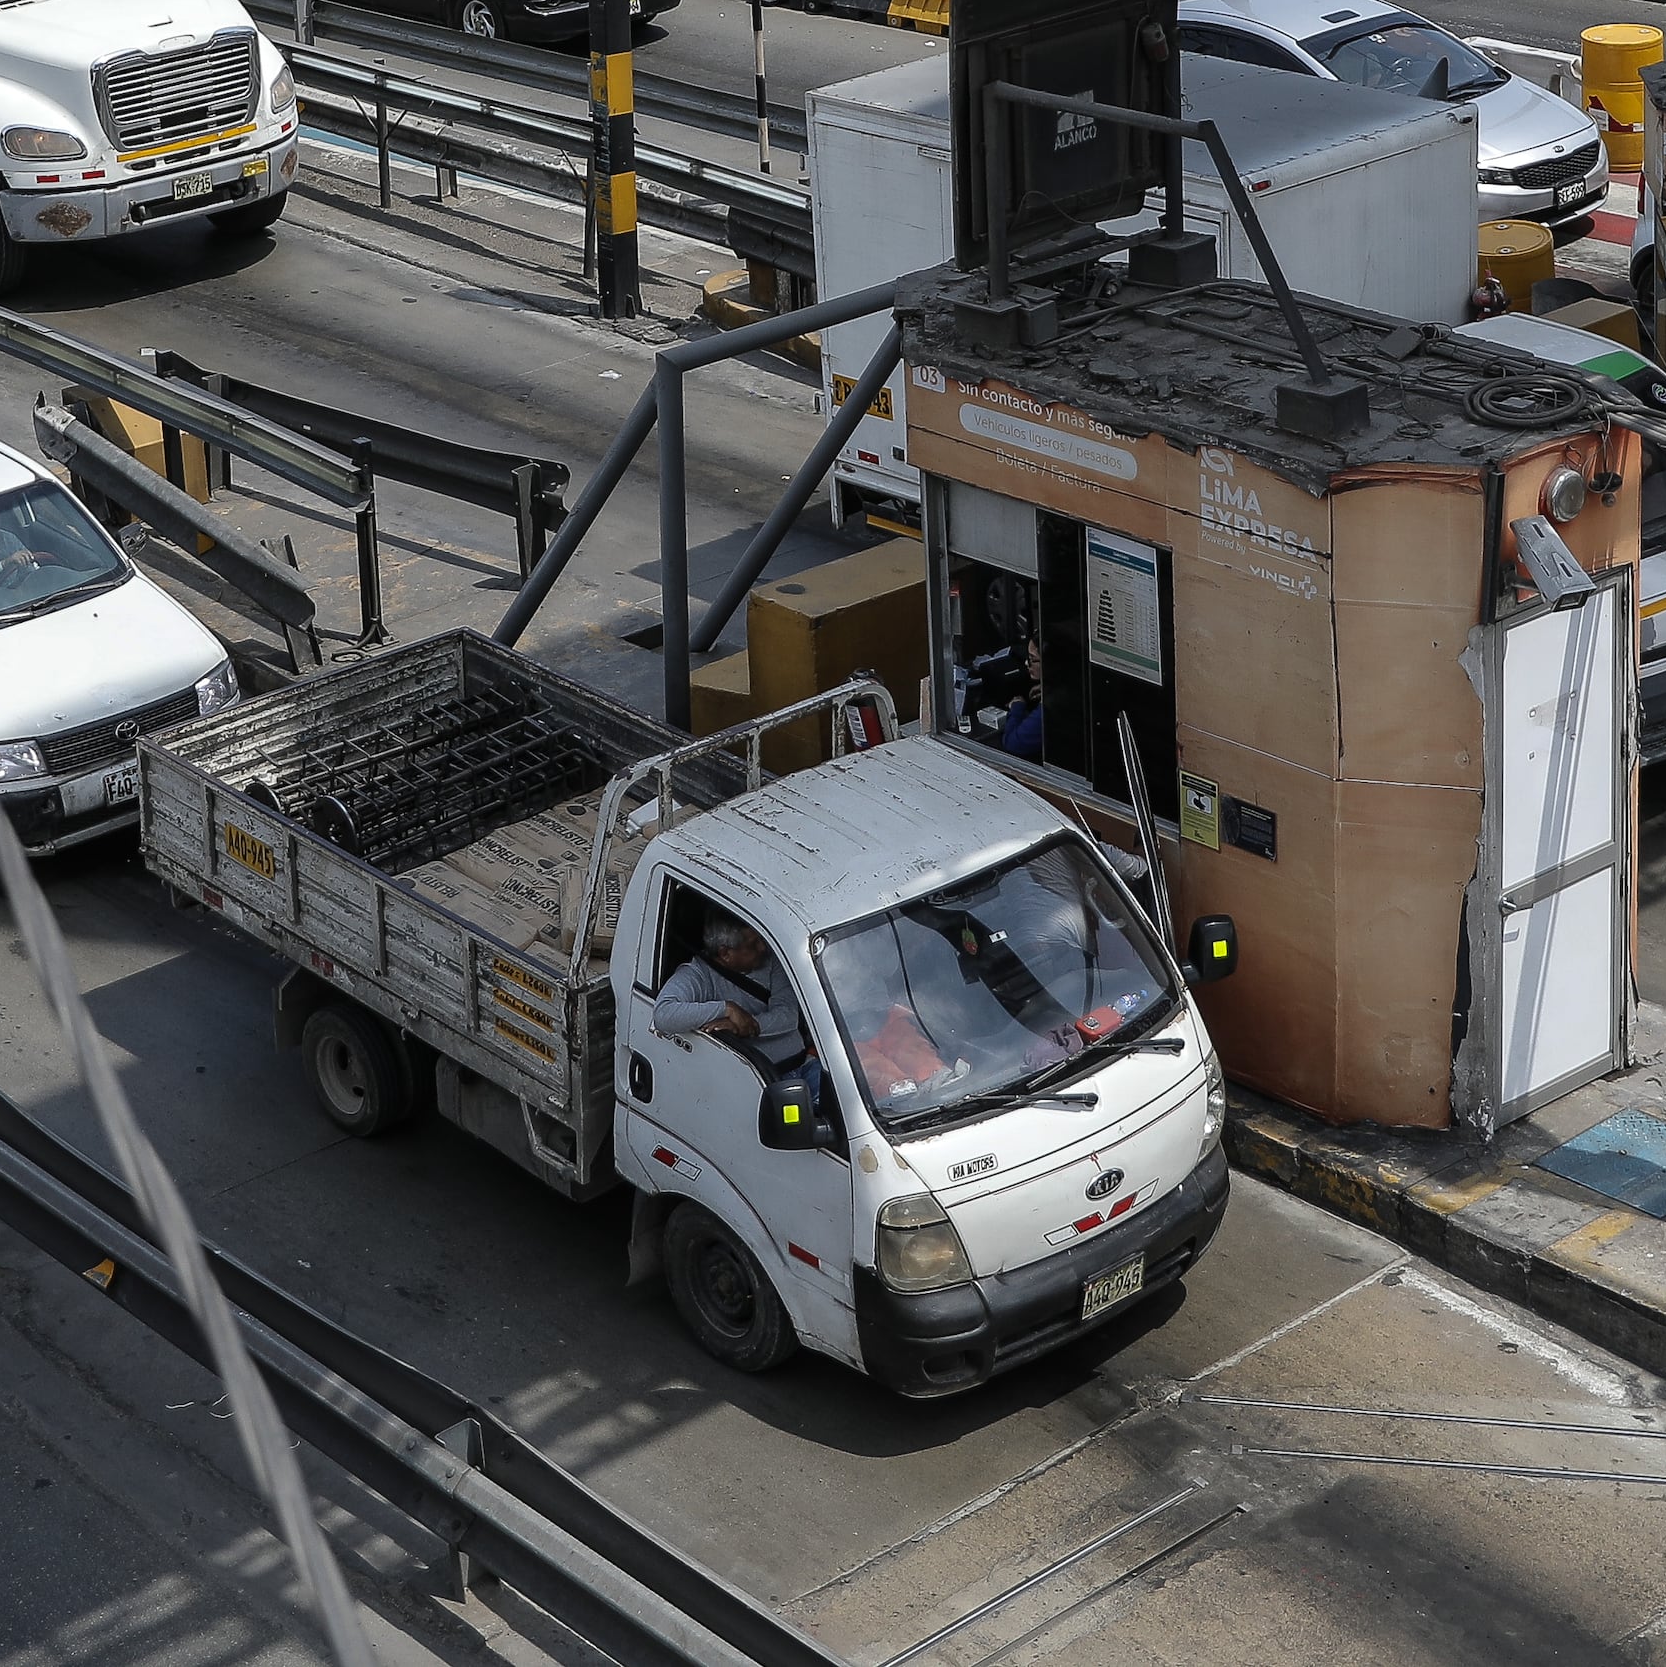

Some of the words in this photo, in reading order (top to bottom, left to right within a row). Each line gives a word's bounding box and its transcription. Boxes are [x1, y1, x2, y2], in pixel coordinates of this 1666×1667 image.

[1054, 125, 1097, 151] ALANCO
[919, 367, 938, 386] 03
[981, 389, 1043, 416] contacto
[1045, 406, 1055, 423] y
[1056, 408, 1085, 430] más
[1029, 426, 1067, 453] ligeros
[1076, 445, 1123, 471] pesados
[1200, 502, 1319, 564] EXPRESA
[1201, 530, 1235, 549] Powered
[1236, 540, 1247, 556] by
[1248, 564, 1295, 589] VINCI
[966, 1155, 995, 1175] MOTORS
[1092, 1173, 1119, 1195] KIA
